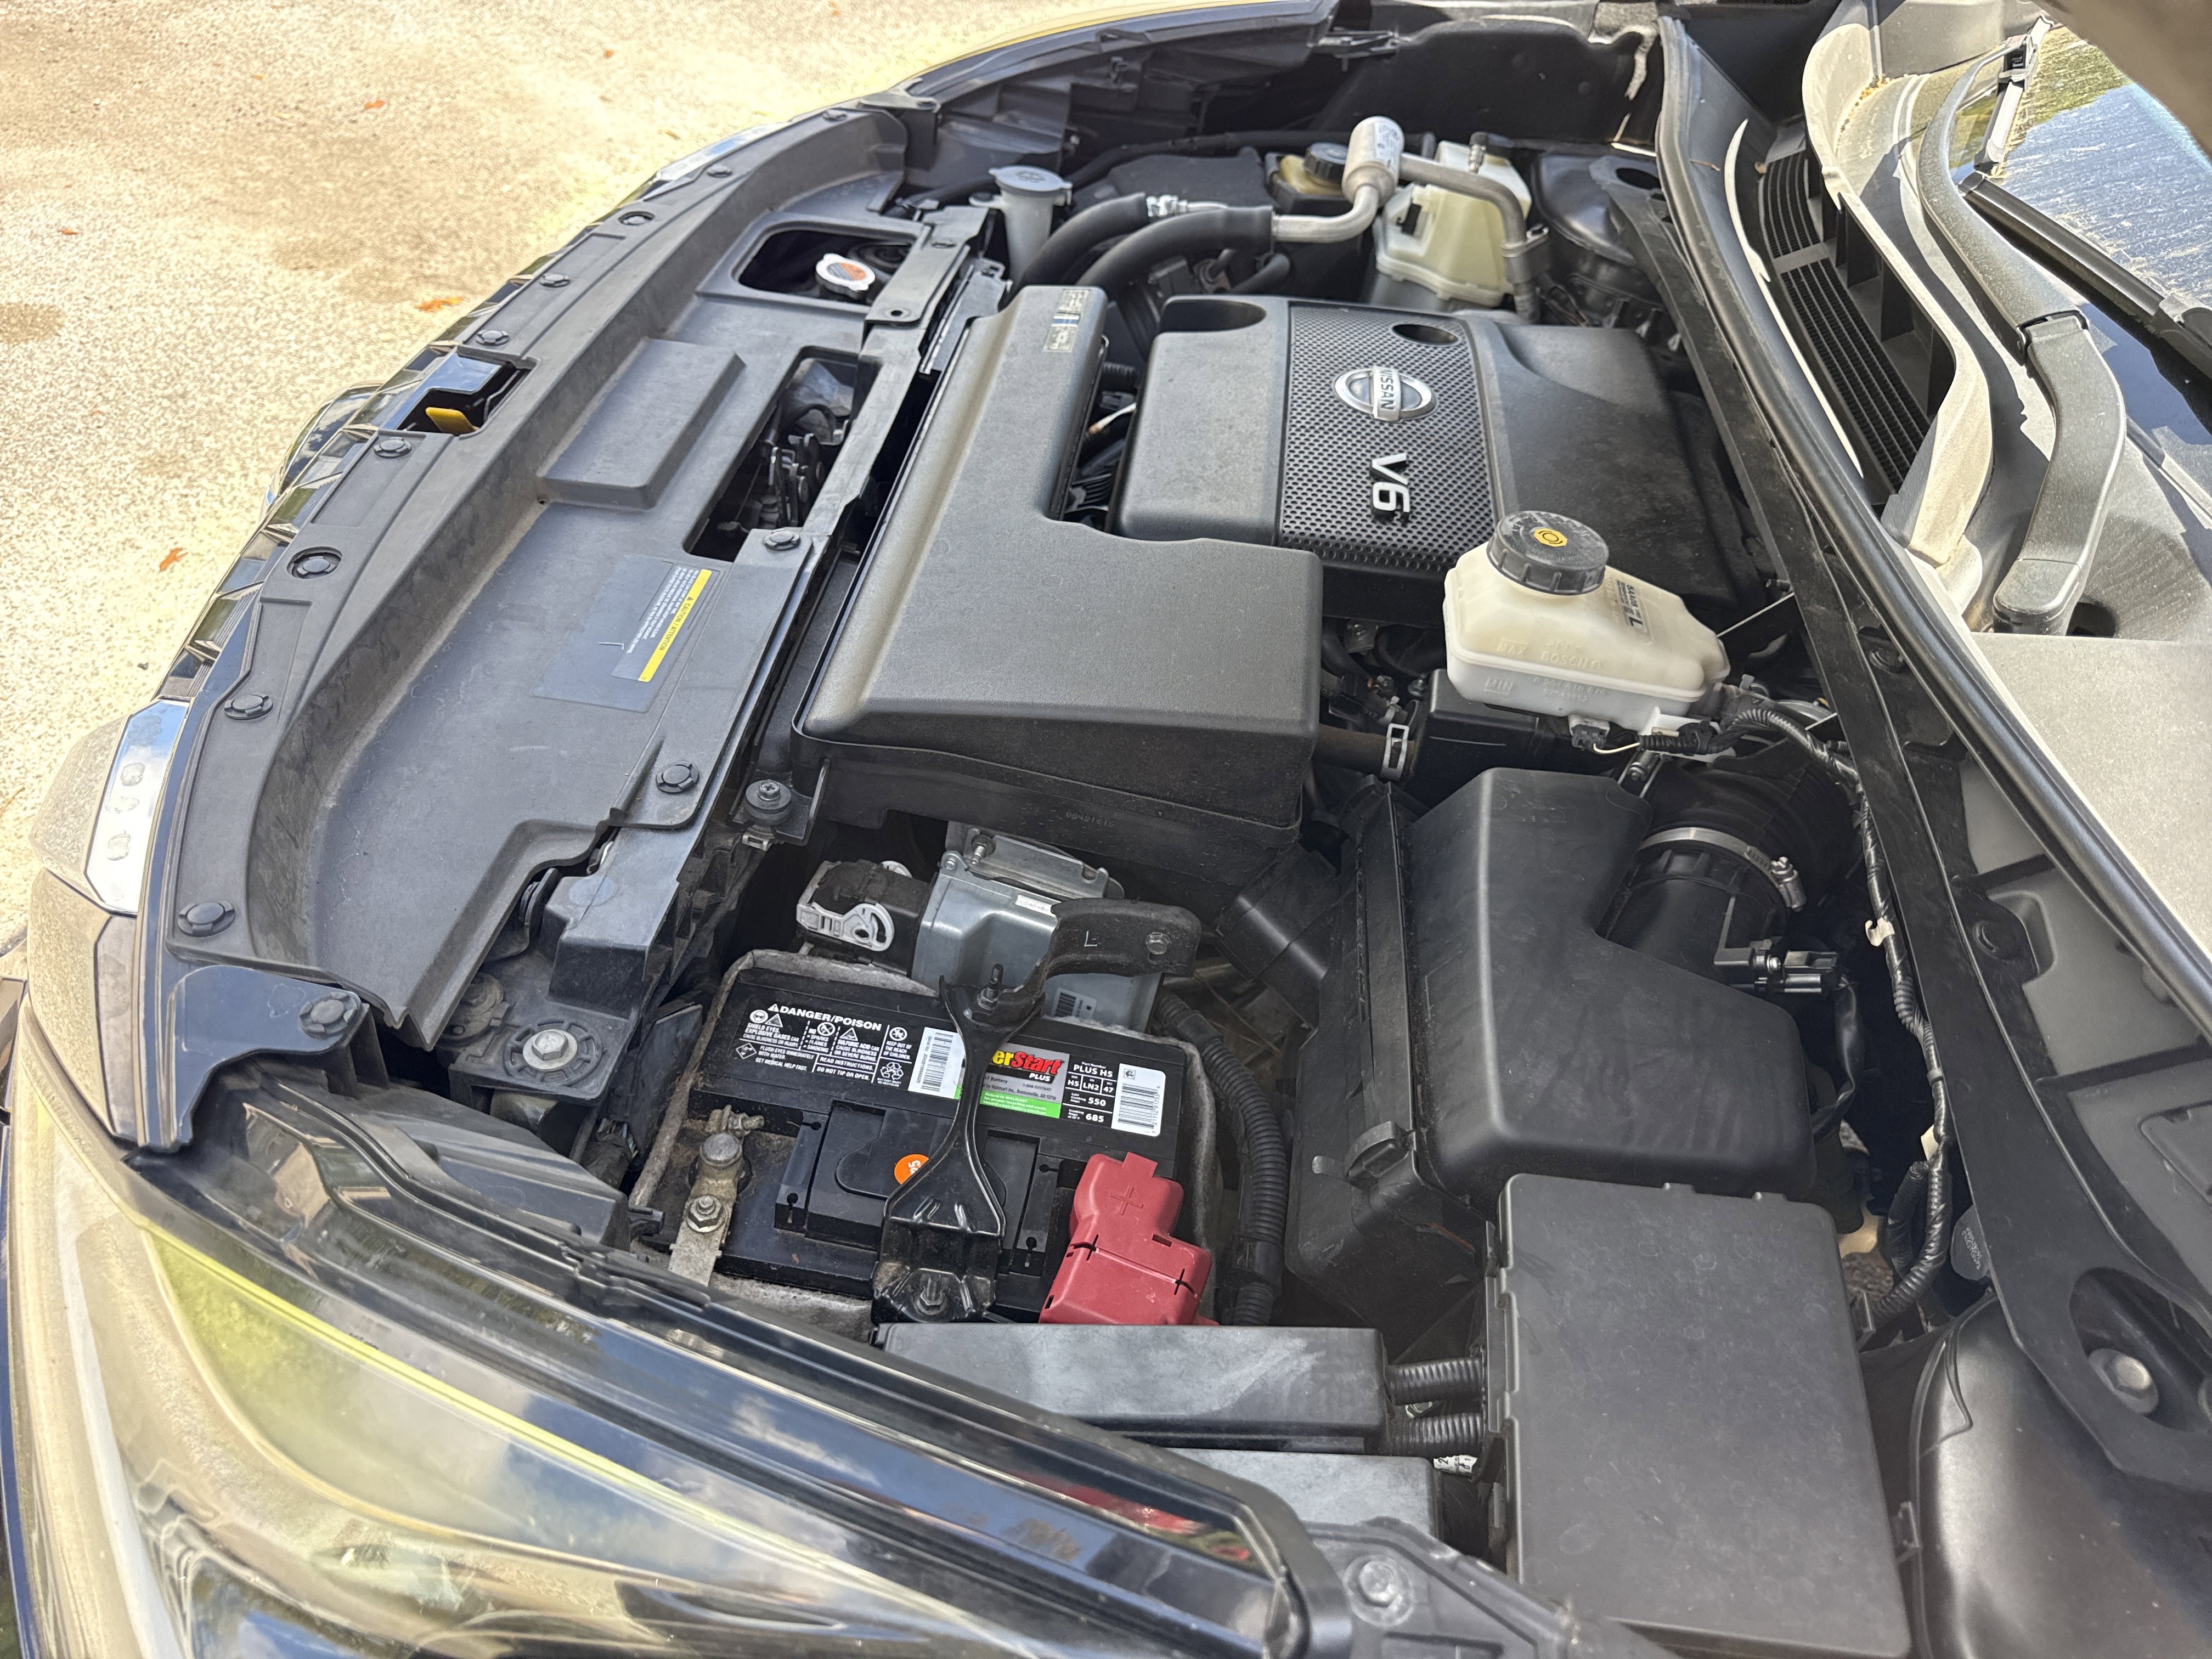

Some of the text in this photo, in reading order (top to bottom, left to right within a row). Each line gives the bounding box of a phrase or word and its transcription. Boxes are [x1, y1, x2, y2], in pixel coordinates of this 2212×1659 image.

[1379, 369, 1395, 410] NISSAN
[1372, 453, 1410, 512] V6
[675, 603, 690, 622] CAUTION
[1628, 616, 1643, 627] L
[659, 627, 677, 650] ATTENTION
[1497, 642, 1527, 657] MAX
[1485, 678, 1514, 692] MIN
[1084, 931, 1097, 947] L
[780, 1006, 882, 1031] DANGER/POISON
[745, 1028, 773, 1038] EXPLOSIVE
[756, 1035, 777, 1044] BLINDNESS
[837, 1039, 860, 1048] SULFURIC
[786, 1049, 815, 1060] IMMEDIATELY
[806, 1045, 830, 1053] SMOKING
[851, 1048, 877, 1056] BLINDNESS
[889, 1052, 911, 1060] CHILDREN.
[764, 1059, 783, 1067] MEDICAL
[834, 1059, 874, 1071] INSTRUCTIONS.
[991, 1049, 1063, 1075] erStart
[1073, 1064, 1114, 1078] PLUS H5
[854, 1073, 871, 1081] OPEN.
[1029, 1073, 1051, 1082] PLUS
[1082, 1082, 1099, 1091] LN2
[1088, 1097, 1107, 1107] 550
[1085, 1113, 1105, 1122] 685
